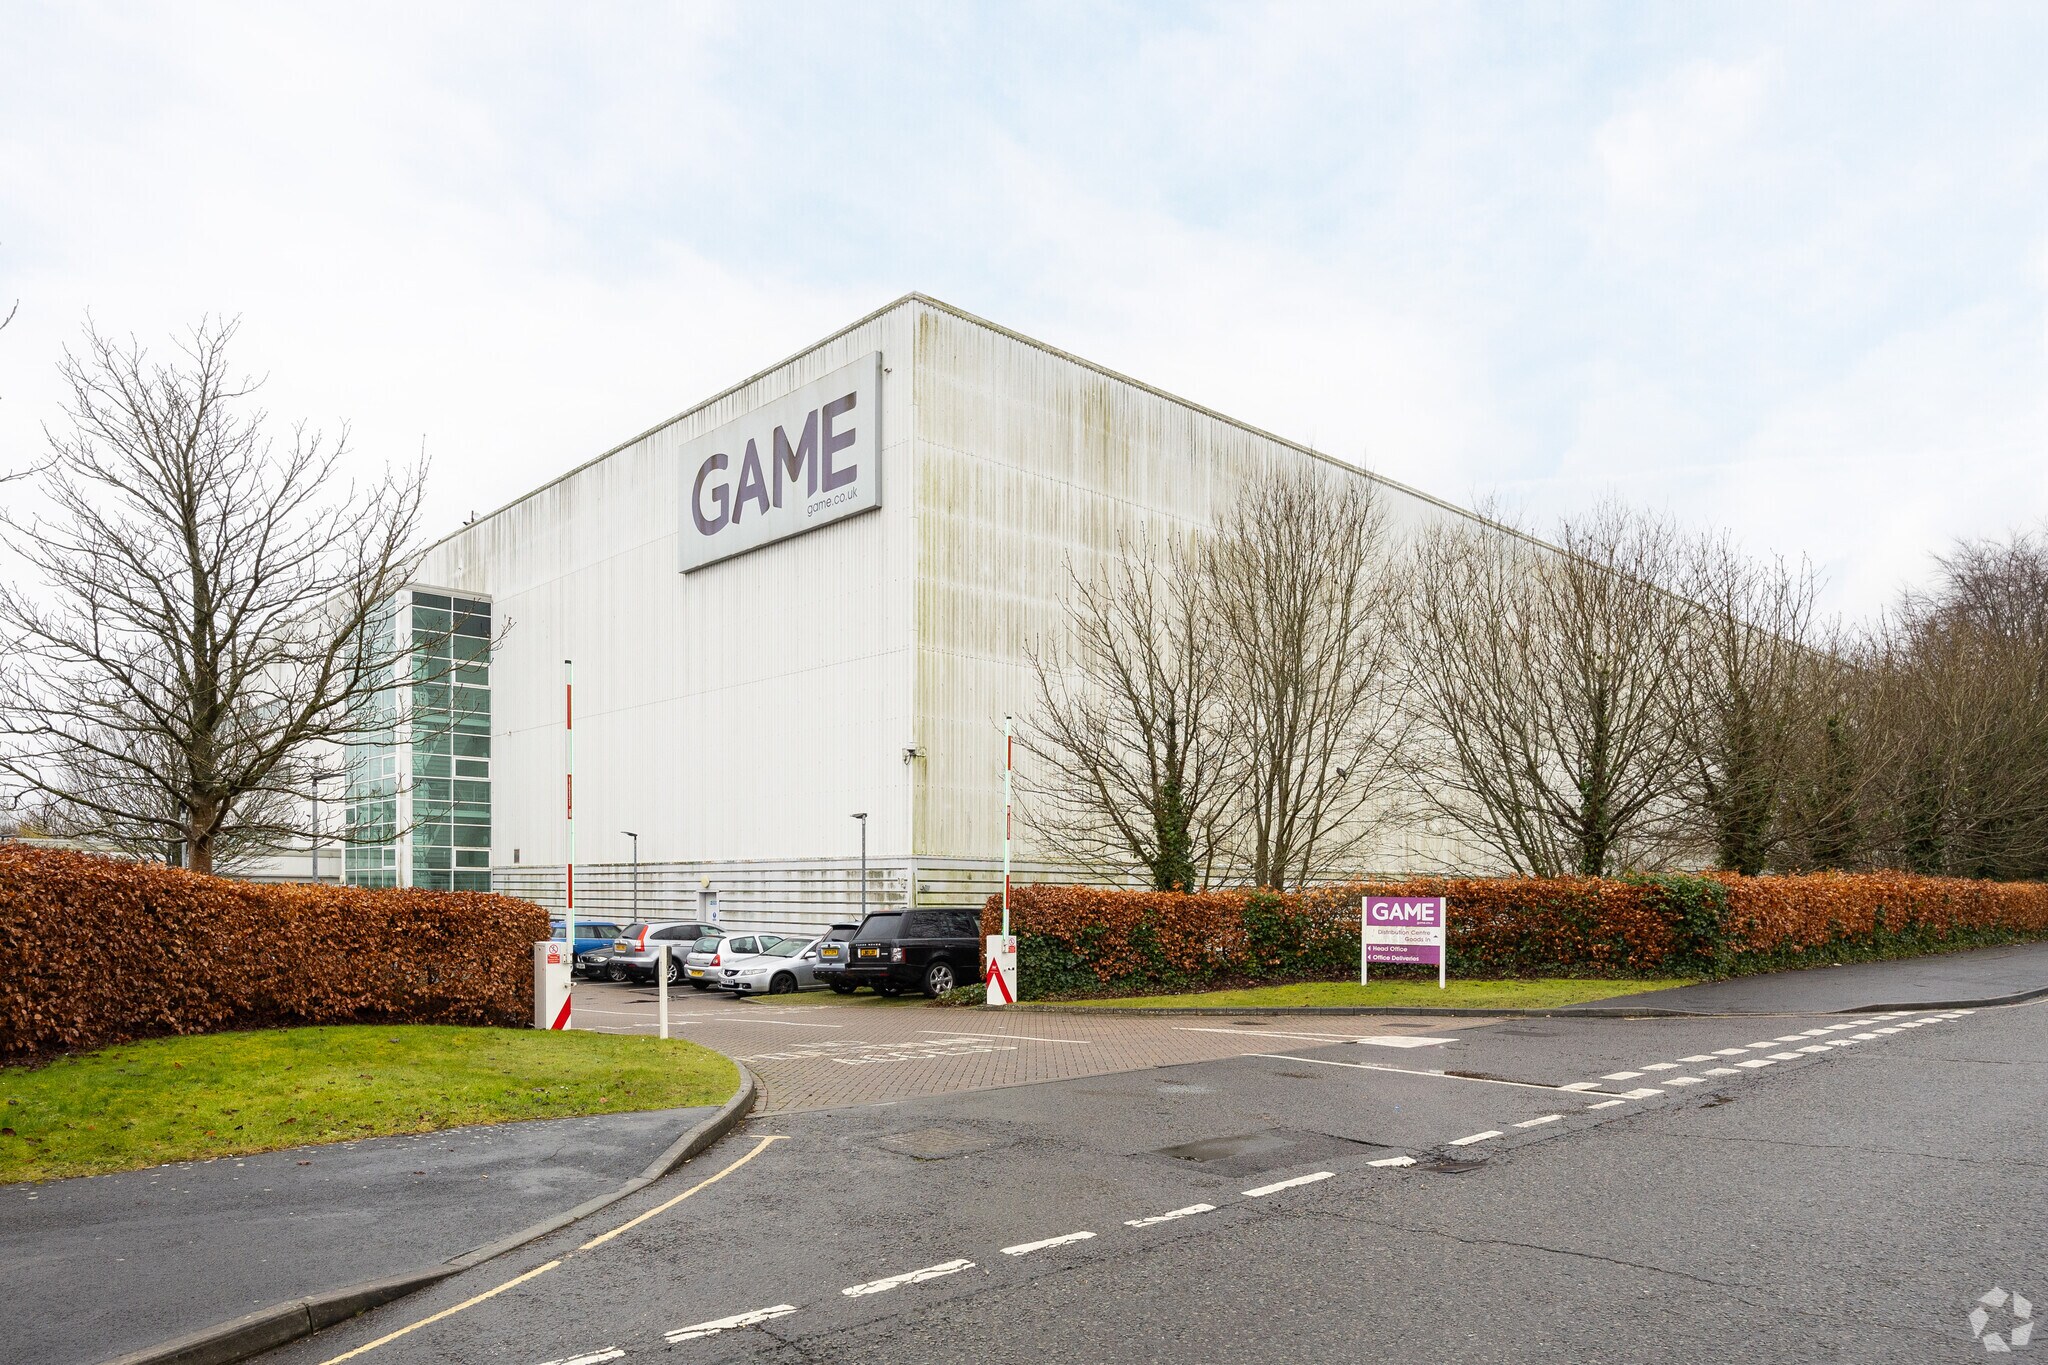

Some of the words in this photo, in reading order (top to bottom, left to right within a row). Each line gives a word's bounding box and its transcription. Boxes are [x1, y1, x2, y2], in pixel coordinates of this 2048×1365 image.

[692, 391, 857, 536] GAME
[807, 486, 858, 517] game.co.uk
[1372, 903, 1434, 921] GAME
